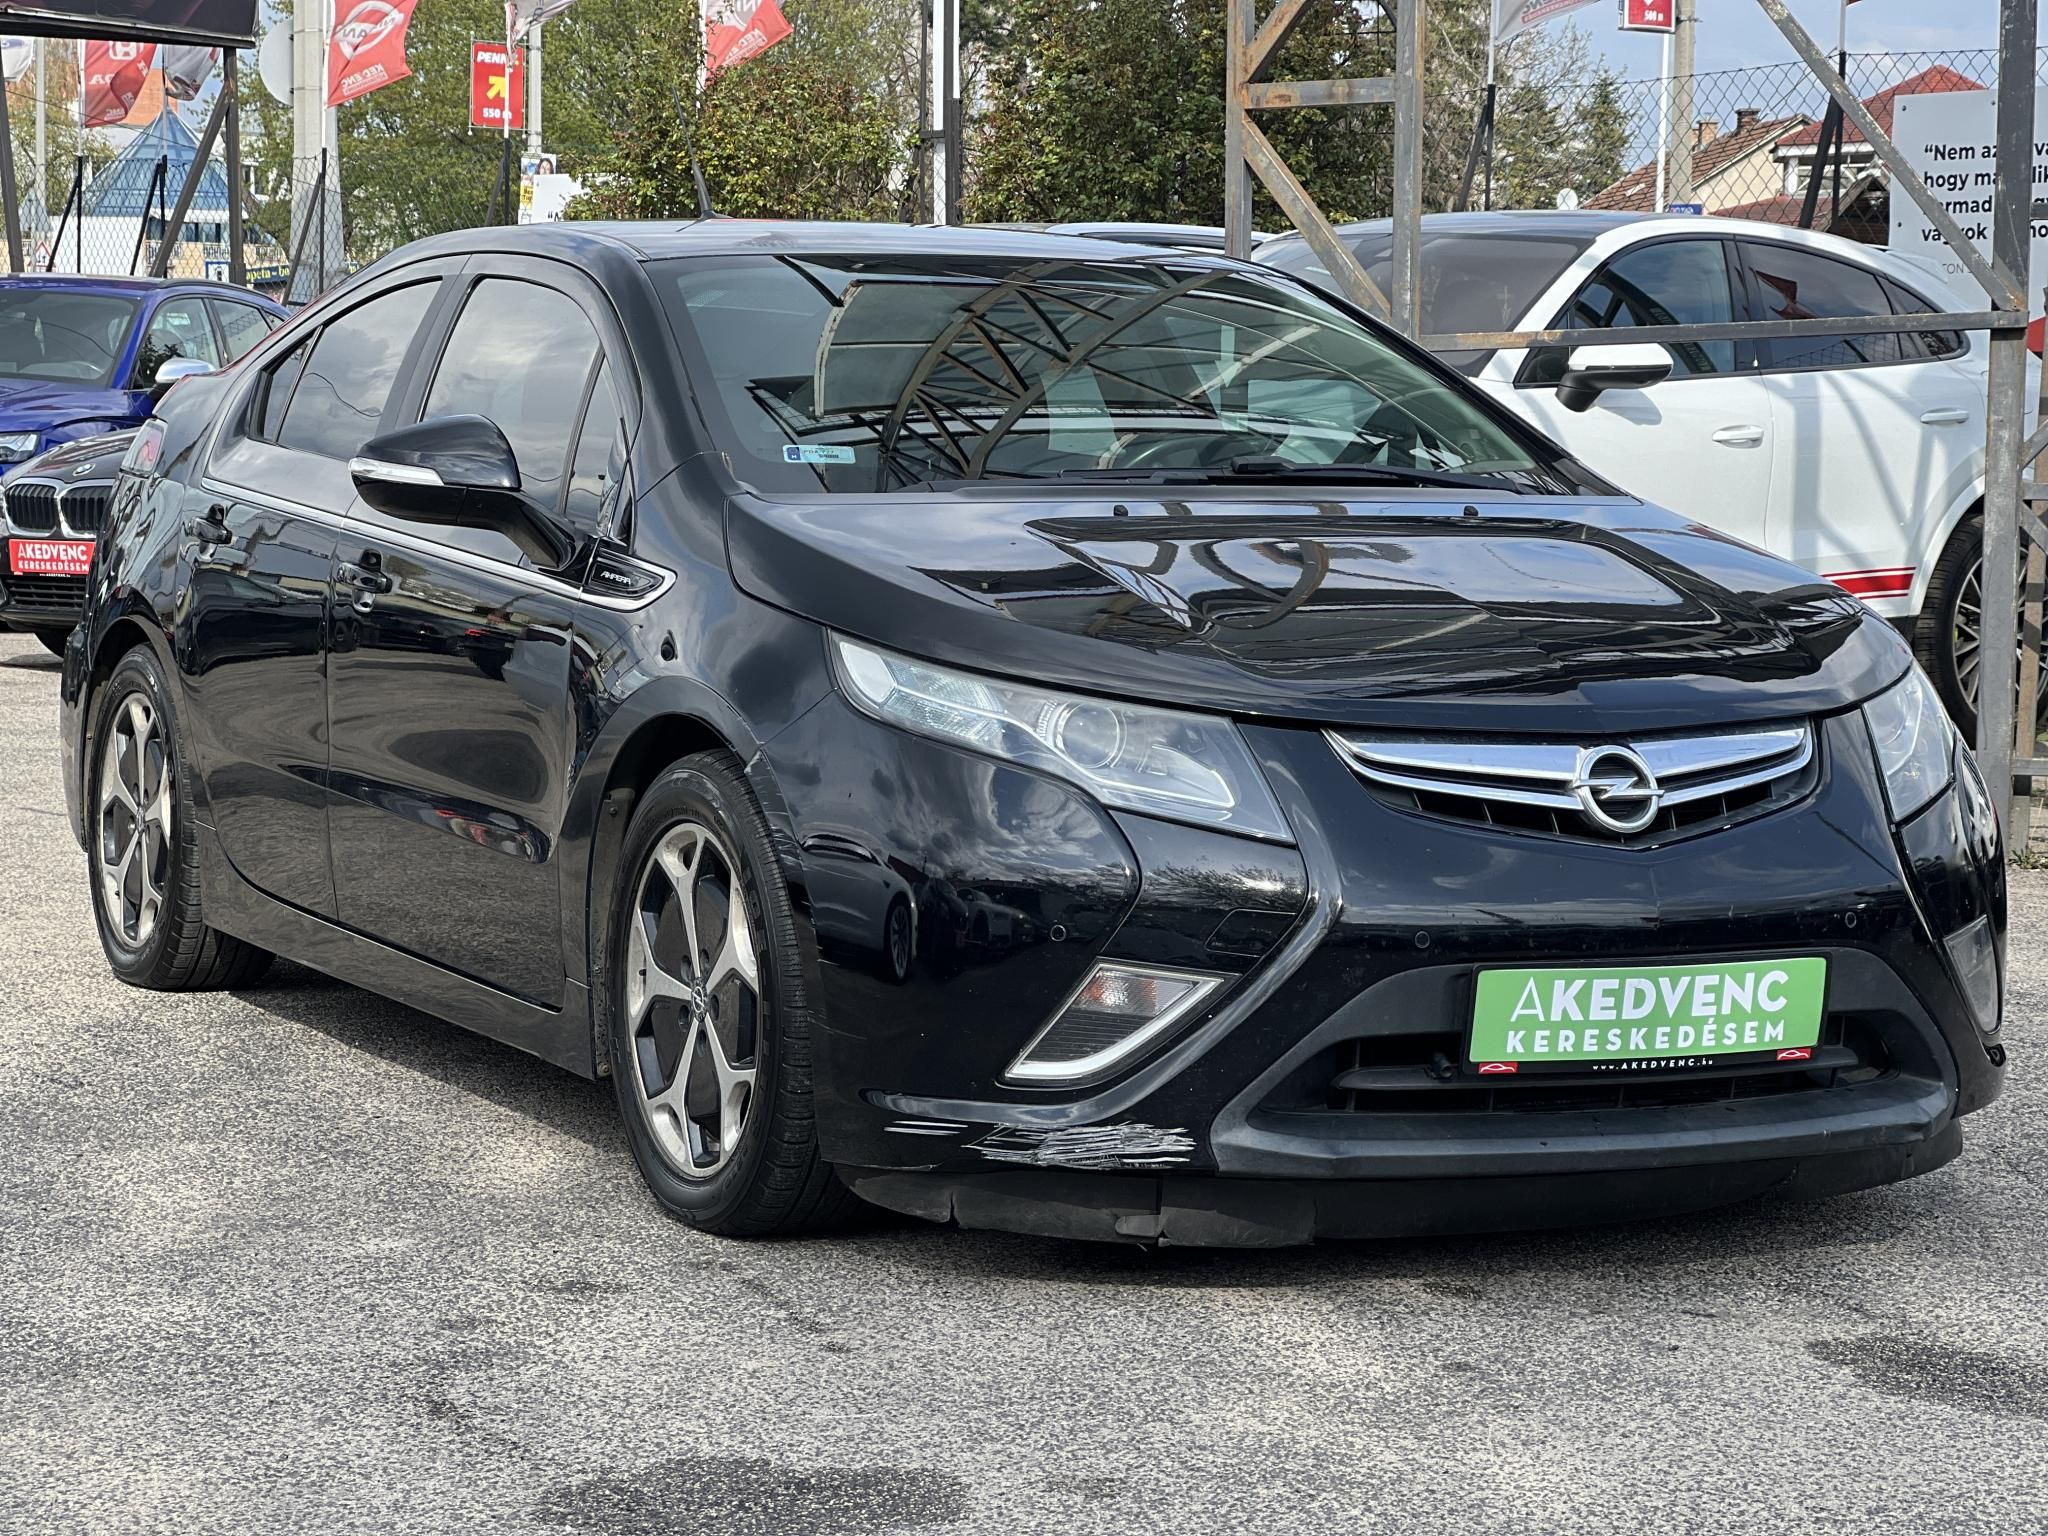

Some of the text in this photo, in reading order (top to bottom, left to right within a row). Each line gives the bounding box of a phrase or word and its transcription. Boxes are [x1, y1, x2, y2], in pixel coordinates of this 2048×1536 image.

[482, 107, 501, 119] 550
[1924, 171, 1969, 191] hogy
[18, 543, 88, 561] AKEDVENC
[18, 560, 89, 572] KERESKEDÉSEM
[1510, 970, 1790, 1023] AKEDVENC
[1506, 1019, 1785, 1054] KERESKEDÉSEM
[1593, 1058, 1713, 1070] www.AKEDVENC.hu
